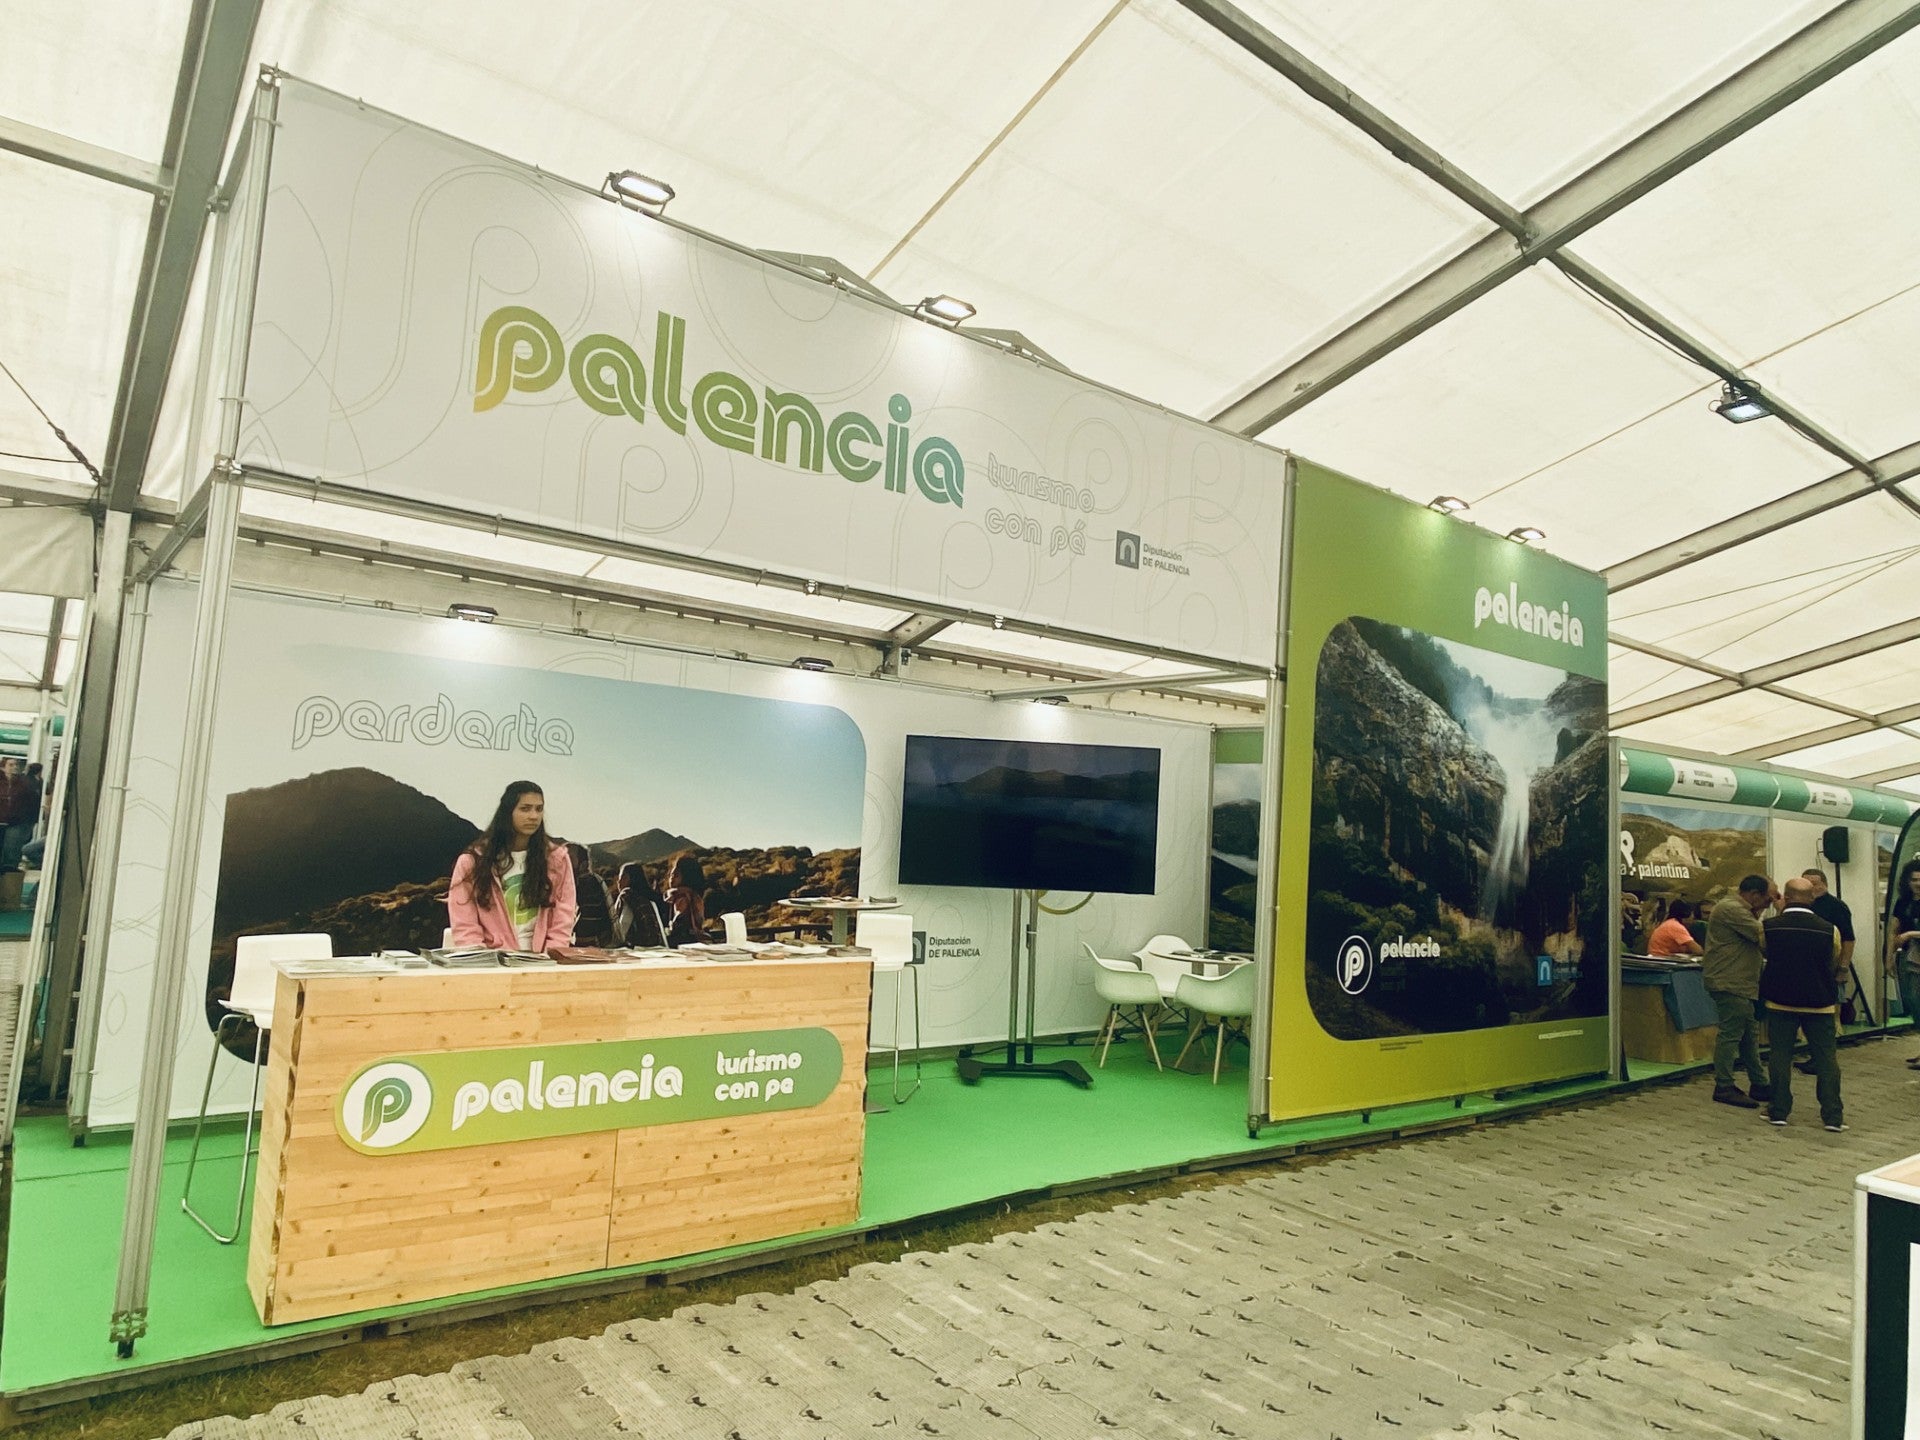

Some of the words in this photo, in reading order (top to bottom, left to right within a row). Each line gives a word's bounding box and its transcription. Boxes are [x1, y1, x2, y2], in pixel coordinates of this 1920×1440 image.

[473, 305, 965, 509] palencia
[987, 451, 1096, 514] turismo
[984, 507, 1043, 546] con
[1142, 556, 1153, 567] DE
[1154, 559, 1191, 576] PALENCIA
[1143, 543, 1183, 562] Diputación
[1474, 581, 1584, 648] palencia
[1638, 862, 1690, 880] palentina
[928, 949, 941, 958] DE
[942, 948, 981, 957] PALENCIA
[929, 936, 971, 946] Diputación
[1380, 935, 1441, 964] palencia
[716, 1048, 803, 1076] turismo
[451, 1053, 684, 1132] palencia
[714, 1080, 760, 1101] con
